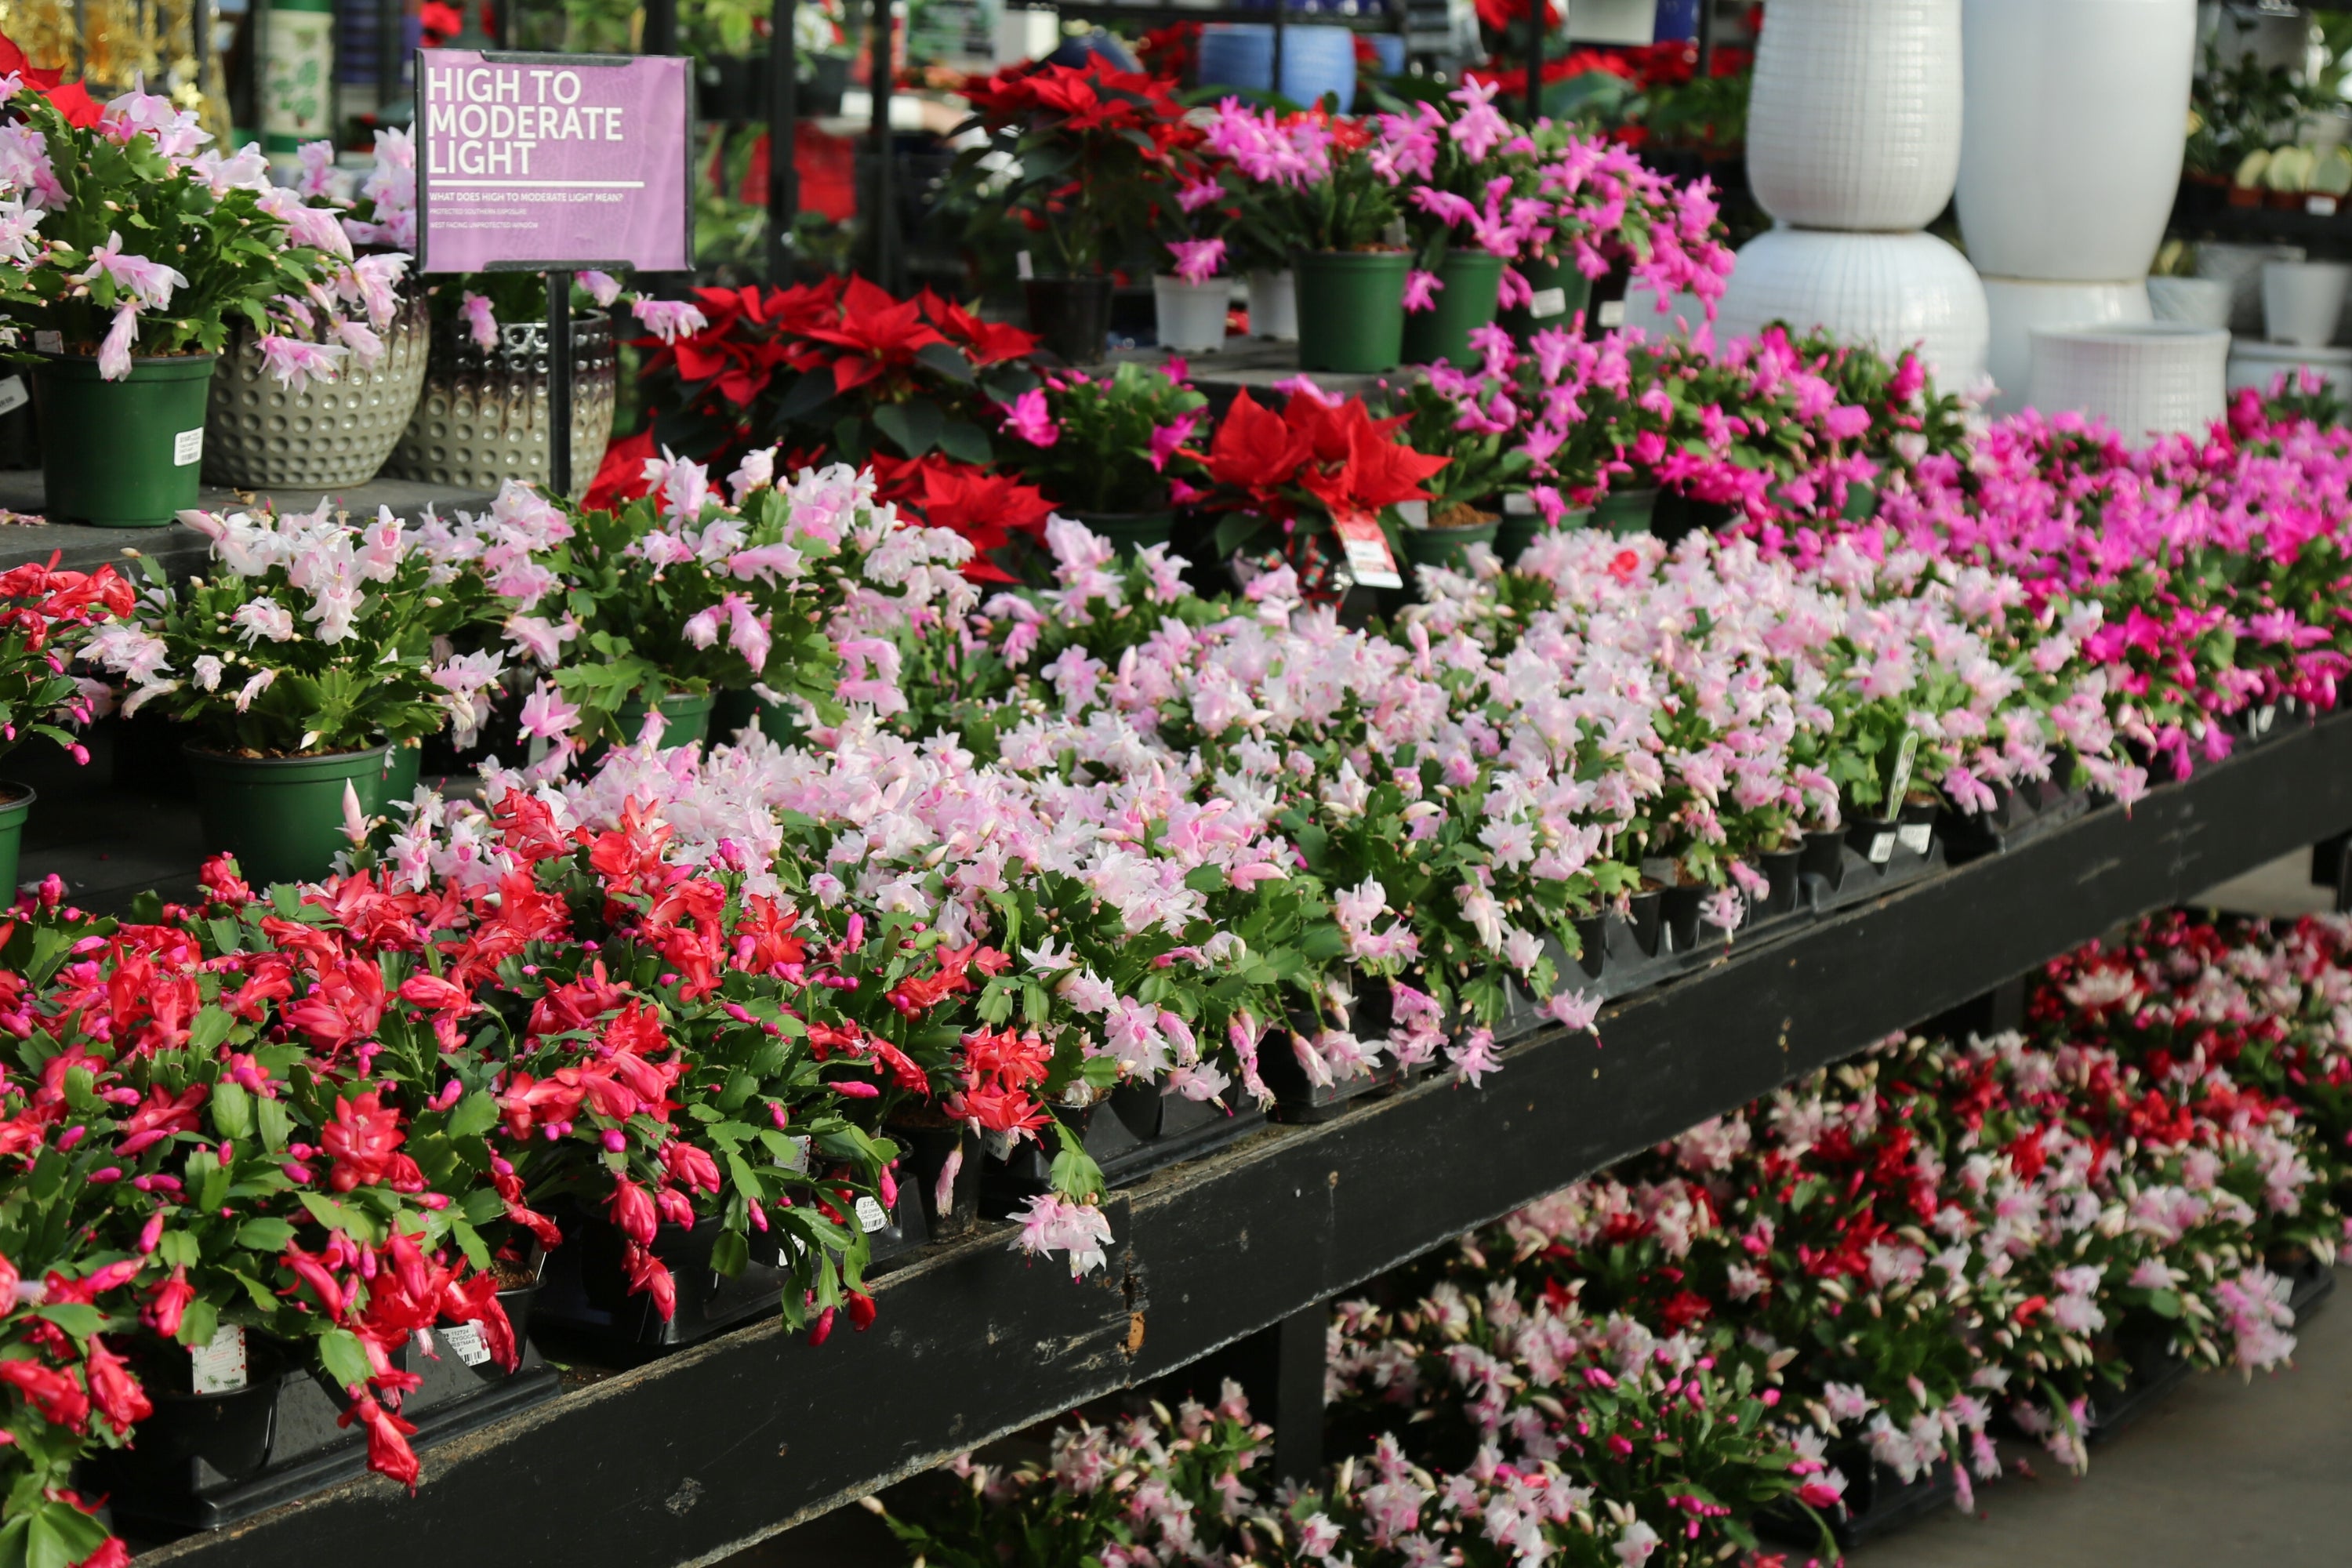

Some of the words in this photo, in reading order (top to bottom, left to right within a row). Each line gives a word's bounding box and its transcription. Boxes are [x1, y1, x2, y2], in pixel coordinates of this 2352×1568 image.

[427, 67, 520, 103] HIGH
[530, 70, 582, 104] TO
[427, 103, 624, 141] MODERATE
[428, 140, 537, 175] LIGHT
[429, 192, 455, 201] WHAT
[456, 192, 481, 201] DOES
[482, 193, 505, 201] HIGH
[507, 193, 519, 201] TO
[521, 193, 567, 202] MODERATE
[568, 193, 593, 202] LIGHT
[595, 193, 623, 202] MEAN?
